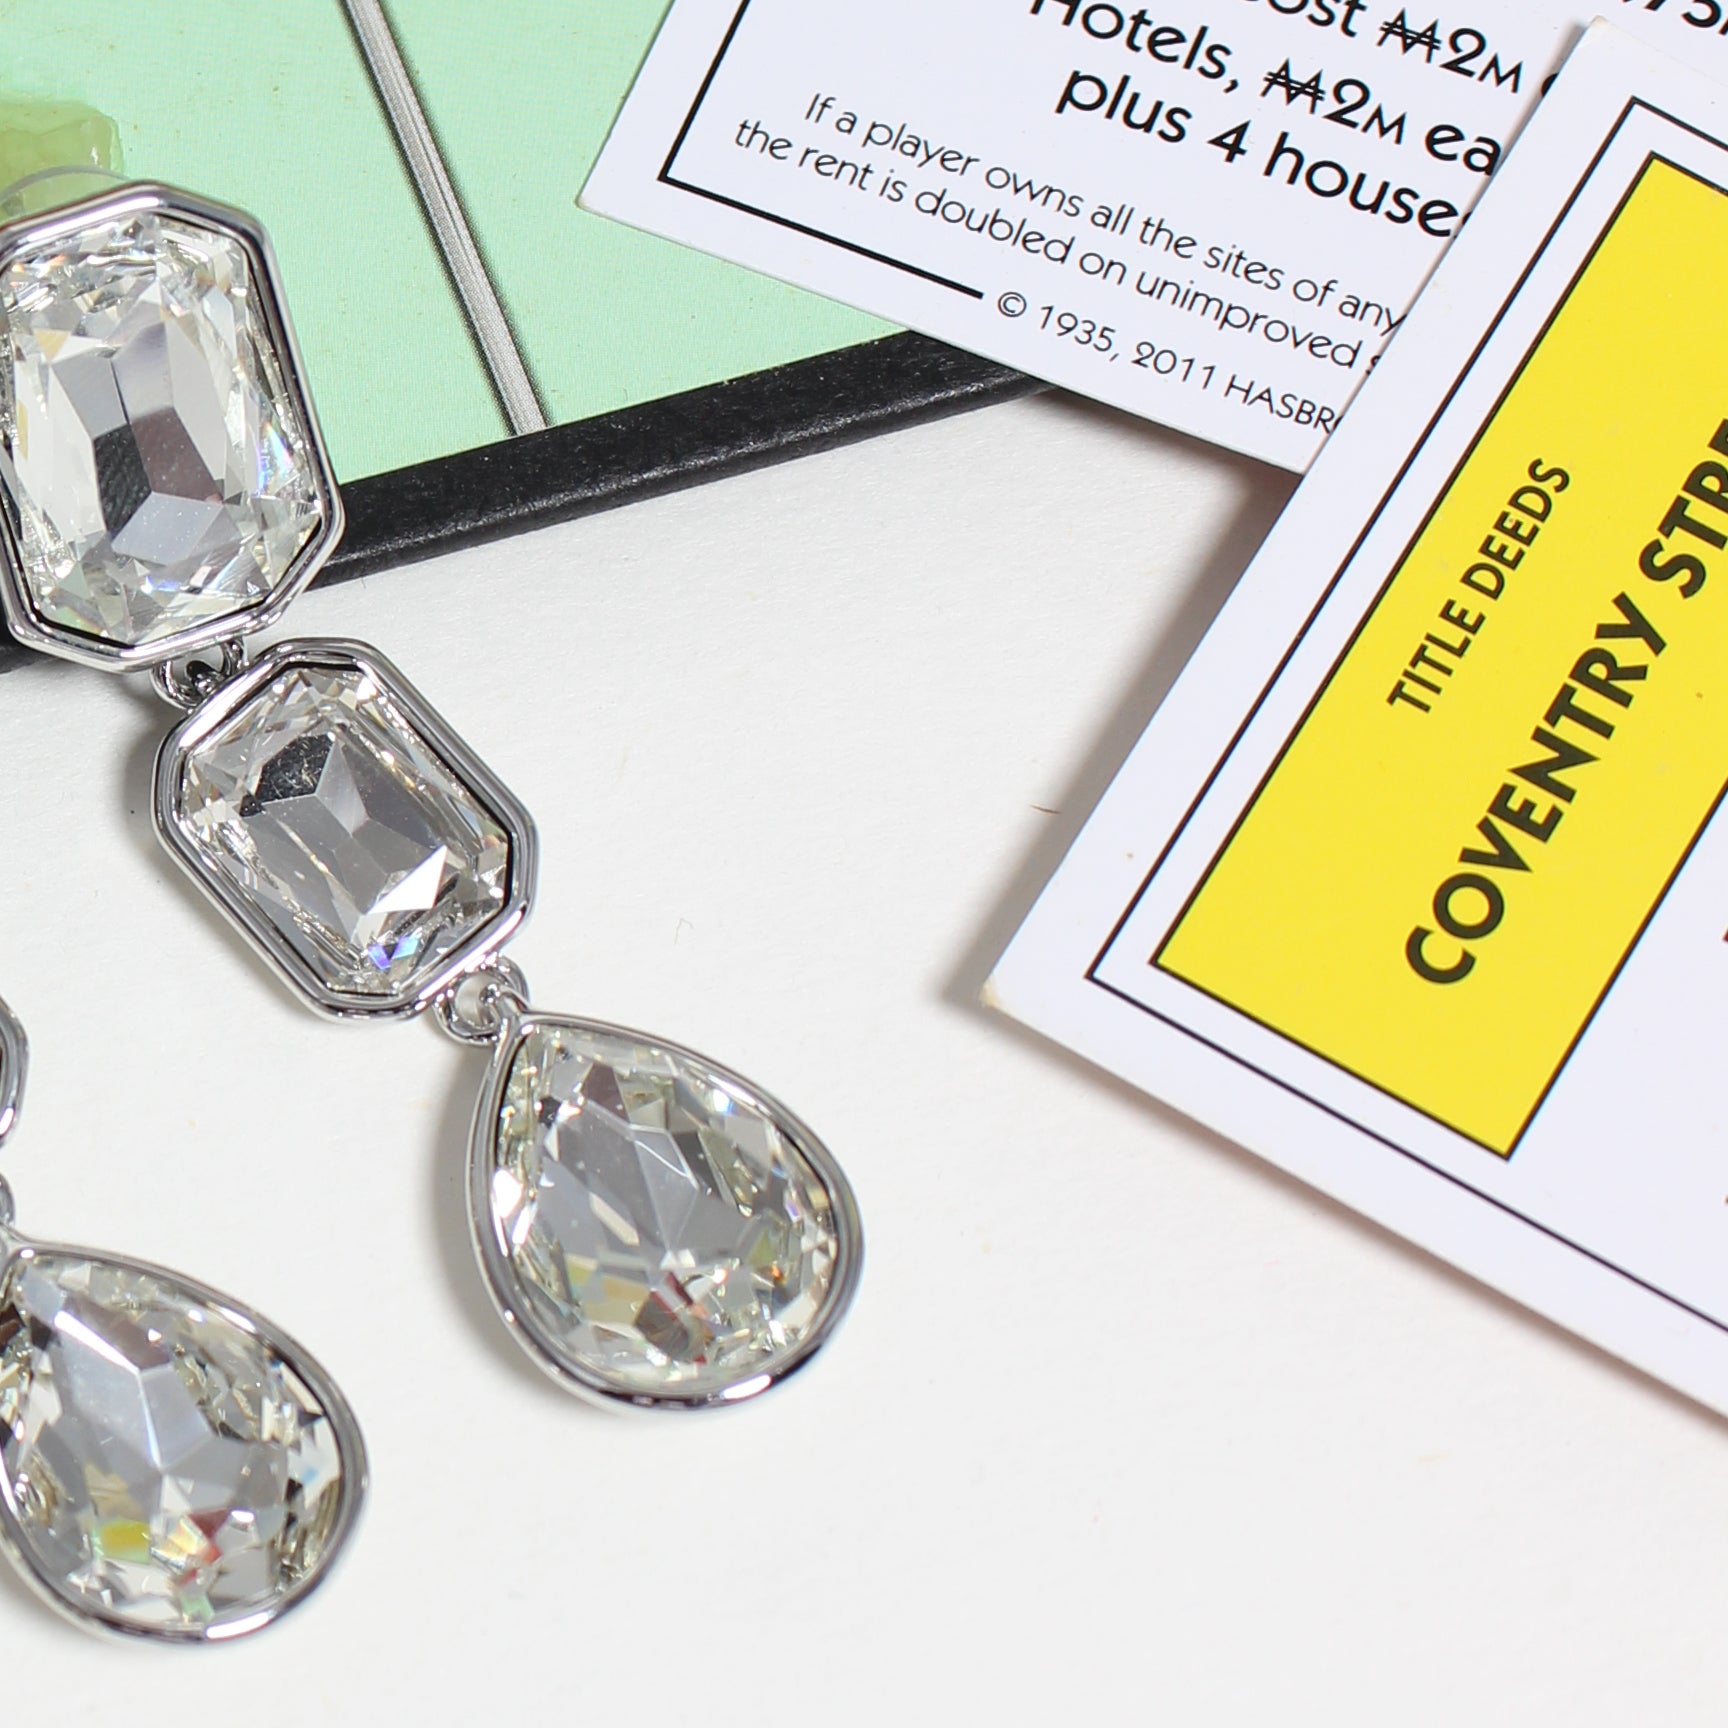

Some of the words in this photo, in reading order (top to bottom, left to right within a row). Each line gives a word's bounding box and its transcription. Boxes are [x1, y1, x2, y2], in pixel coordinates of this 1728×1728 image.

[734, 119, 793, 160] the
[798, 146, 875, 192] rent
[878, 169, 908, 203] is
[915, 188, 1075, 264] doubled
[1078, 252, 1127, 286] on
[1135, 270, 1363, 369] unimproved
[805, 93, 837, 124] If
[835, 111, 857, 134] a
[862, 120, 980, 176] player
[985, 166, 1084, 217] owns
[1090, 203, 1135, 235] all
[1138, 217, 1197, 259] the
[1203, 244, 1285, 291] sites
[1293, 278, 1339, 307] of
[1338, 294, 1407, 337] any
[1054, 69, 1193, 144] plus
[1208, 119, 1252, 164] 4
[1263, 131, 1472, 239] house
[1039, 305, 1120, 362] 1935,
[1132, 340, 1216, 390] 2011
[1385, 598, 1486, 714] TITLE
[1459, 457, 1571, 602] DEEDS
[1404, 590, 1667, 985] COVENTRY
